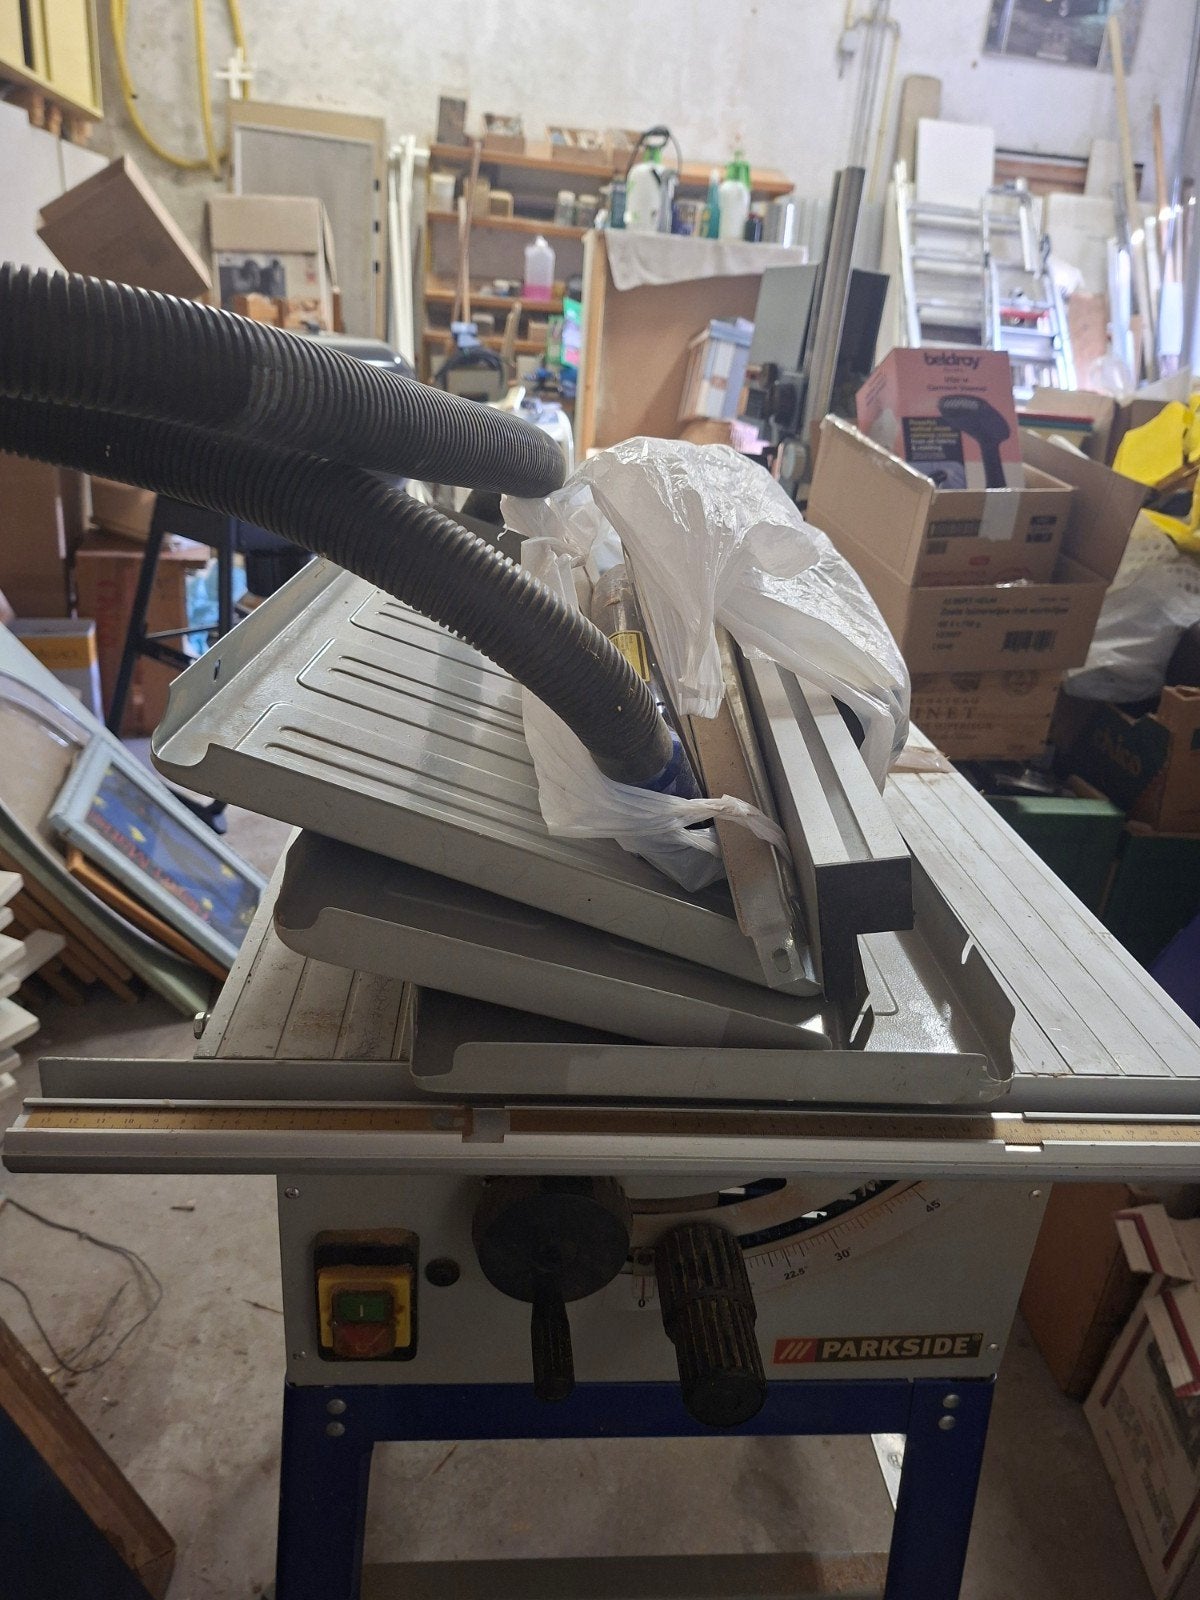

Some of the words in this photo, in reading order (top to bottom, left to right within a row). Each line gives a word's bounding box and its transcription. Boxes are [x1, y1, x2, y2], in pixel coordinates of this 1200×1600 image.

[924, 352, 980, 370] beldray
[914, 707, 976, 719] INET
[123, 1117, 135, 1125] 10
